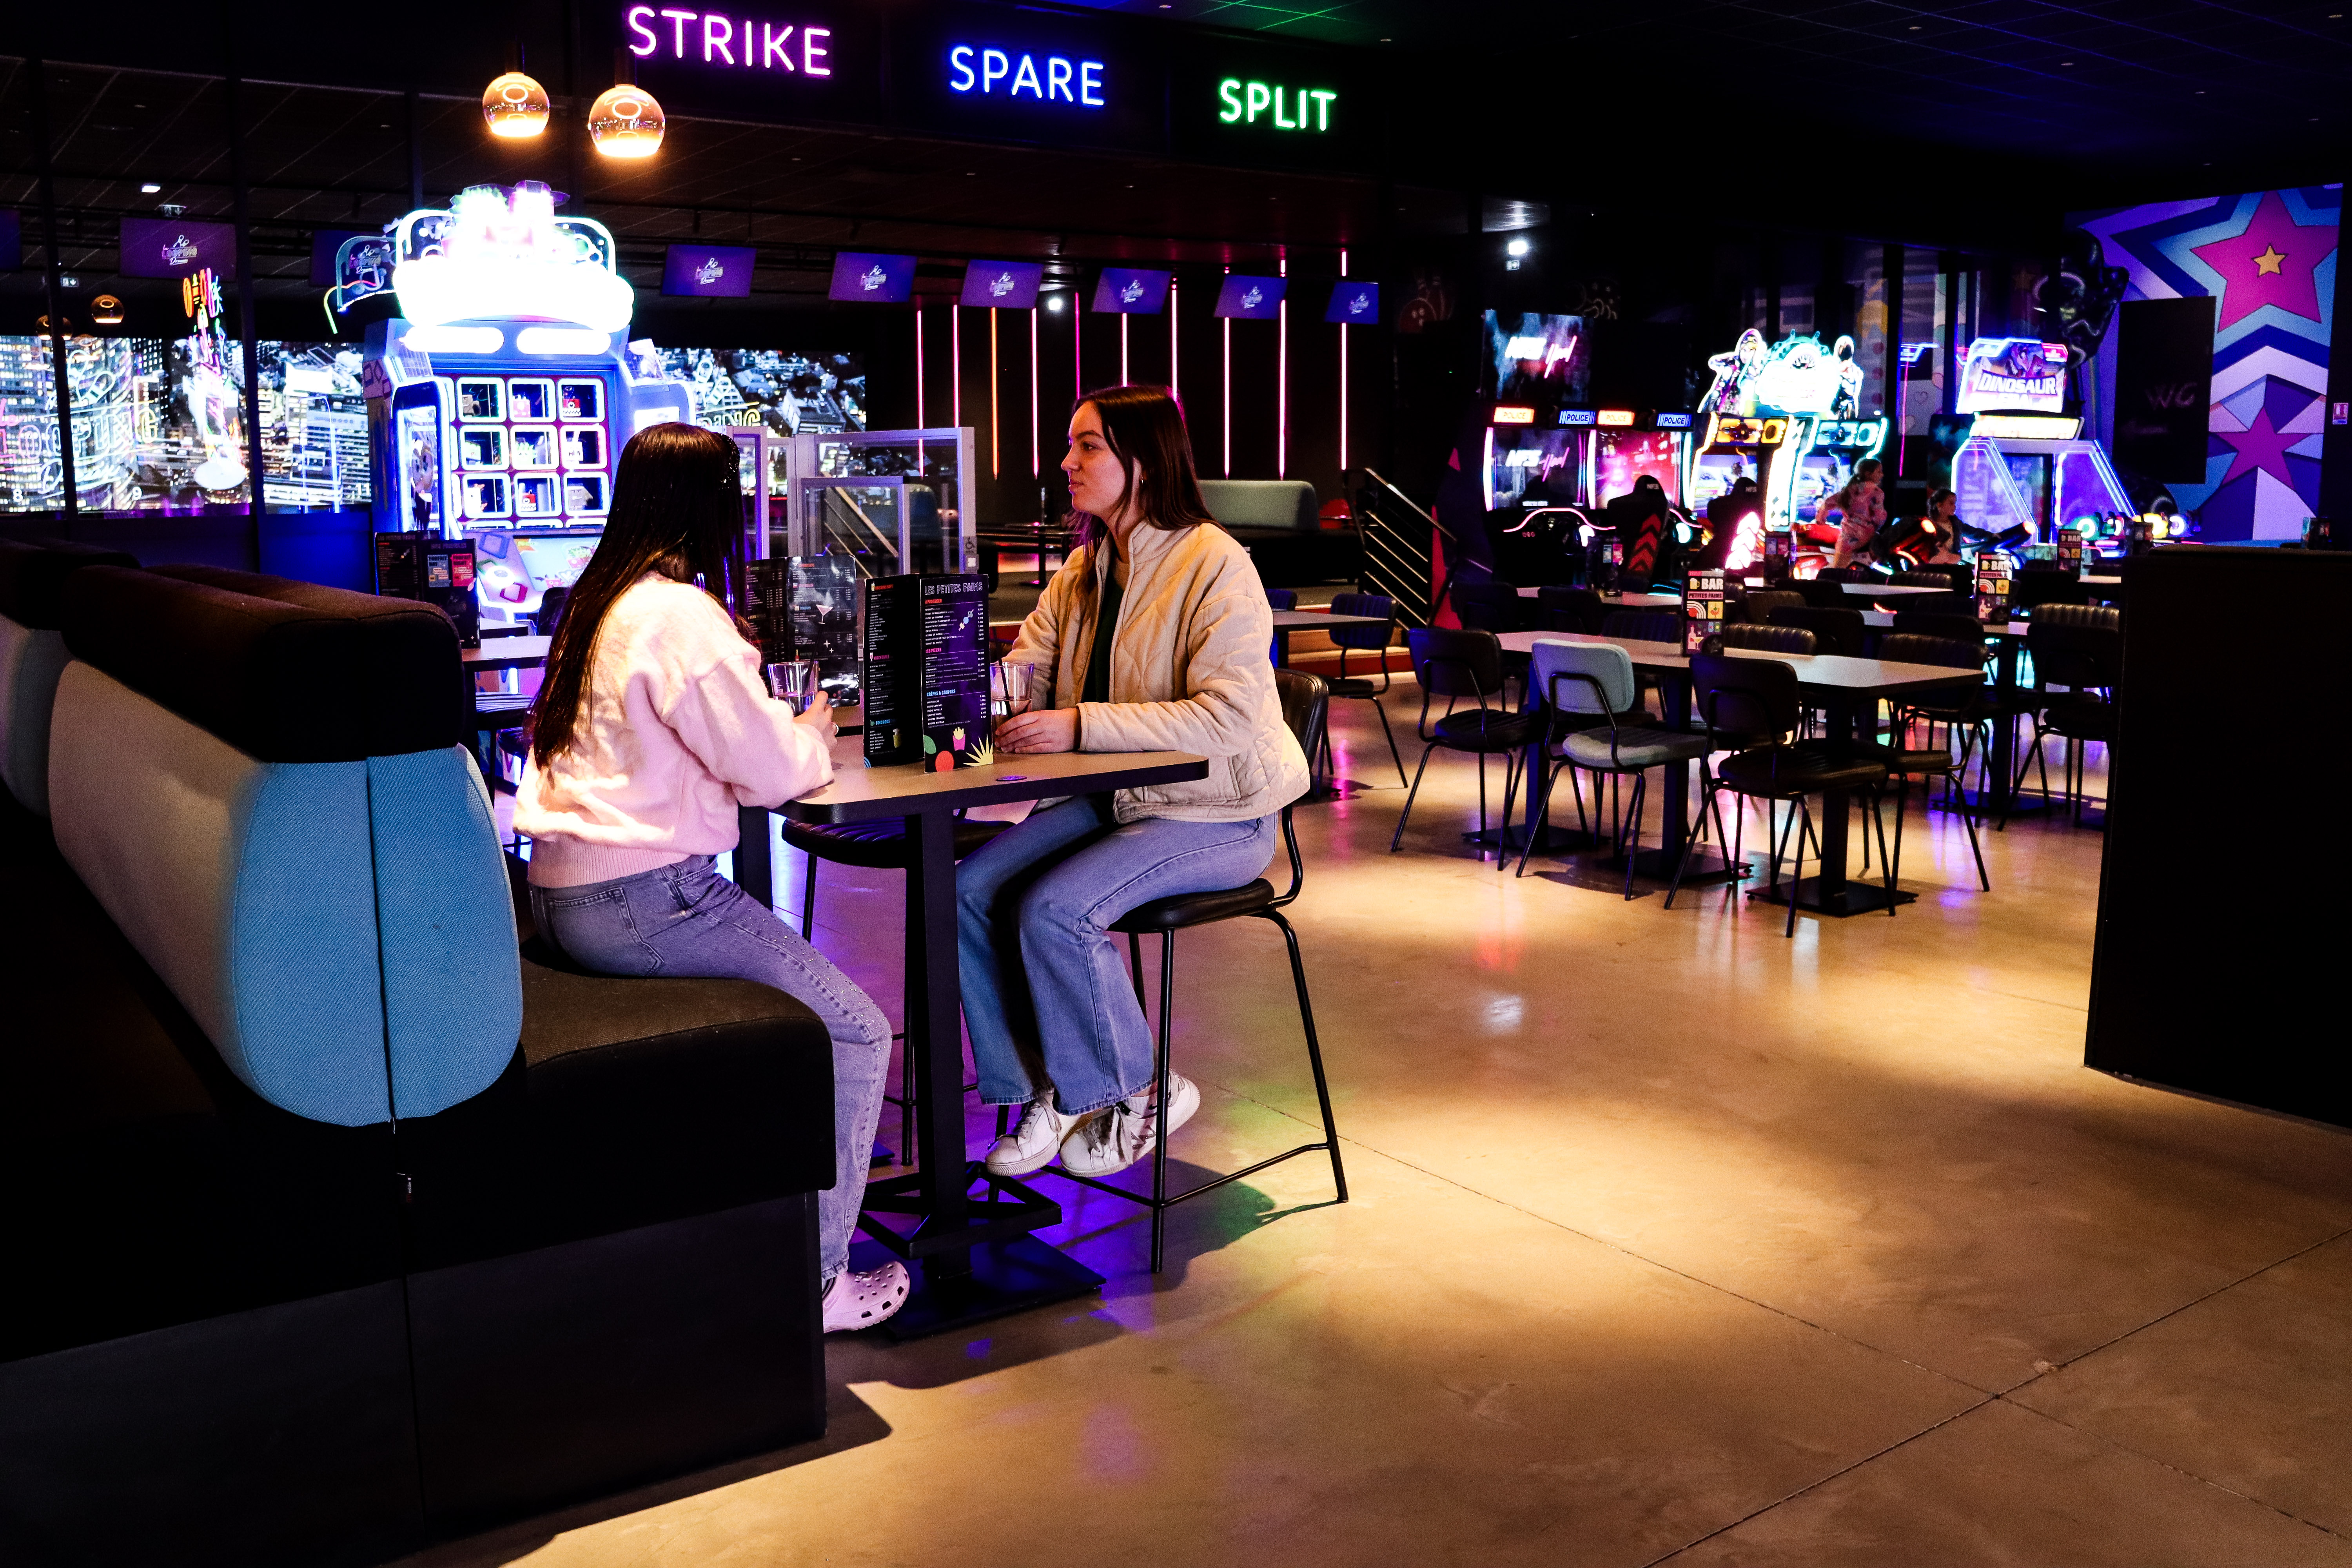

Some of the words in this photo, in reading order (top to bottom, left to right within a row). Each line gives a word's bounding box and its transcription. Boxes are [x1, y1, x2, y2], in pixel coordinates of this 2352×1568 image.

[629, 6, 831, 75] STRIKE
[951, 46, 1104, 105] SPARE
[1220, 80, 1336, 131] SPLIT
[1976, 373, 2057, 394] DINOSAUR
[1566, 414, 1589, 422] POLICE
[13, 489, 23, 502] 8
[132, 486, 142, 500] 9
[925, 586, 935, 595] LES
[936, 584, 961, 594] PETITES
[963, 582, 983, 592] FAIMS
[1701, 578, 1724, 590] BAR
